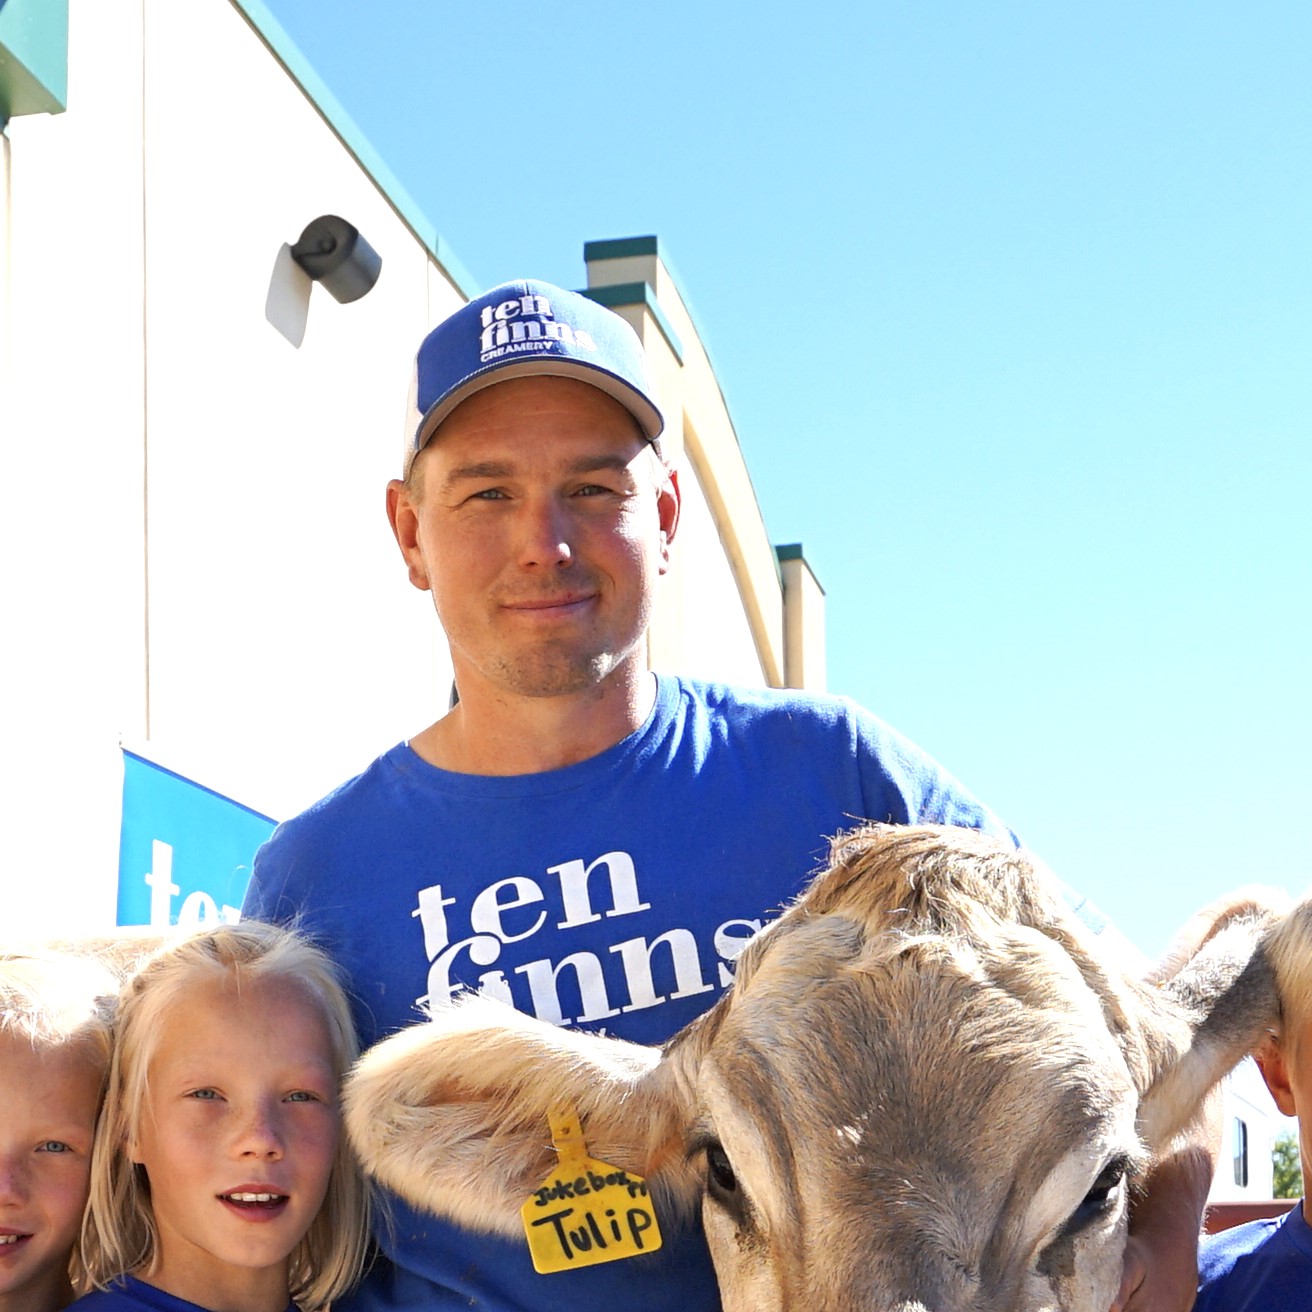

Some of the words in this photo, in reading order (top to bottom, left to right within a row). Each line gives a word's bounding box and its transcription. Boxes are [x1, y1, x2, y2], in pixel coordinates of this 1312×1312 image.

[480, 294, 554, 328] ten
[479, 317, 597, 354] finns
[480, 340, 554, 363] CREAMERY
[411, 850, 652, 963] ten
